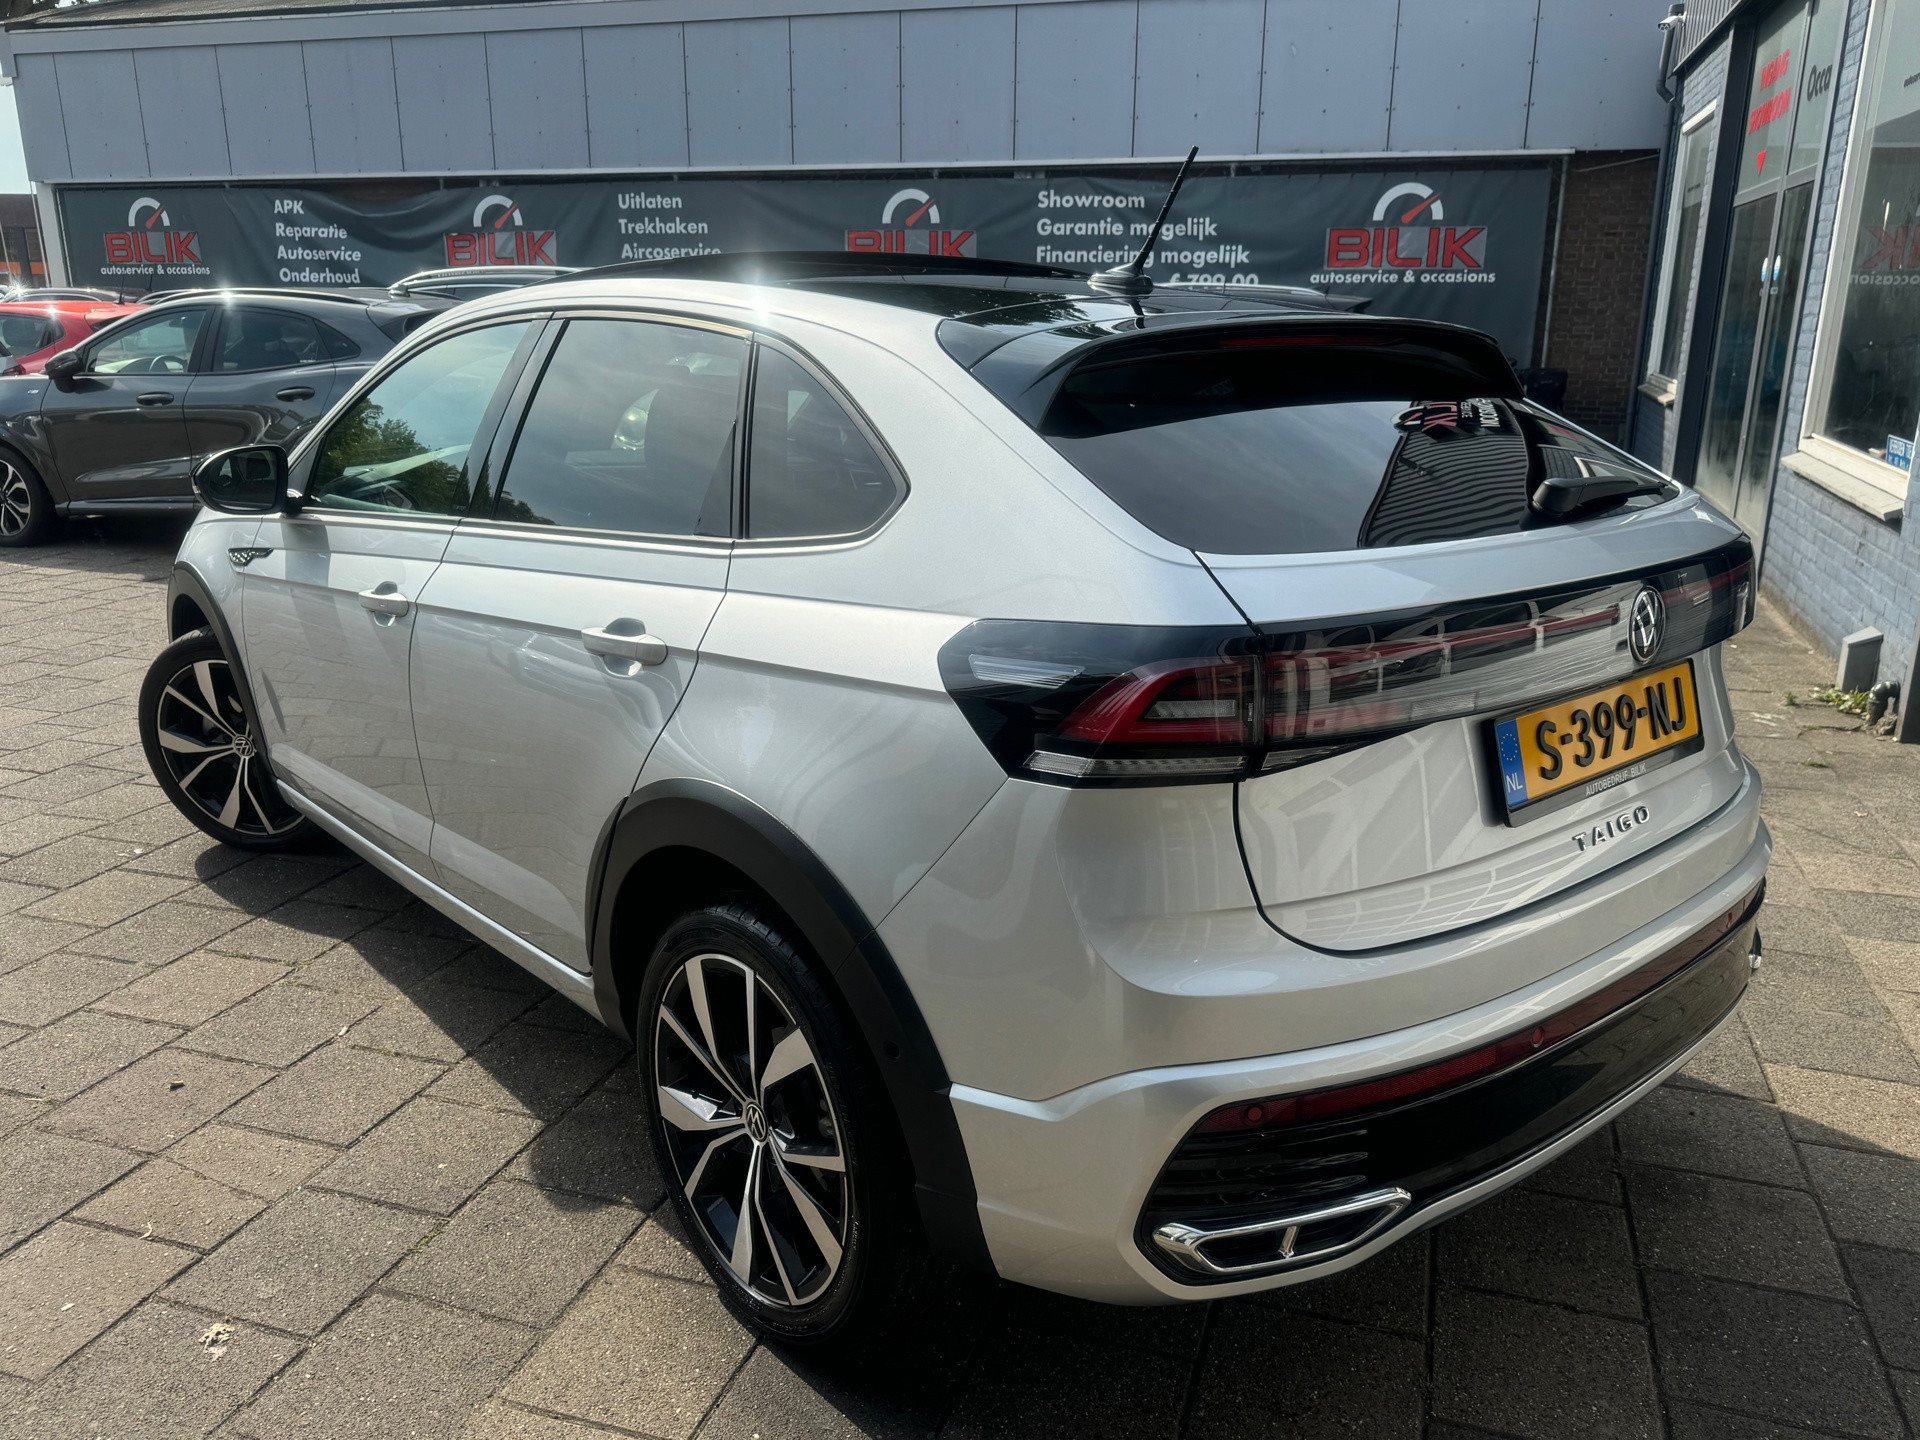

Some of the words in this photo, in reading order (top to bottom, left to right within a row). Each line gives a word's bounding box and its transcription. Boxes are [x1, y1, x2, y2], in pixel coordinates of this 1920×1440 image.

[274, 199, 305, 215] APK
[618, 191, 683, 210] Uitlaten
[1037, 190, 1146, 208] Showroom
[275, 222, 348, 241] Reparatie
[618, 217, 709, 234] Trekhaken
[1036, 217, 1124, 236] Garantie
[104, 231, 202, 263] BILIK
[277, 245, 362, 261] Autoservice
[445, 231, 556, 266] BILIK
[1036, 245, 1155, 268] Financiering
[1160, 245, 1250, 268] mogelijk
[1327, 228, 1486, 268] BILIK
[100, 265, 155, 275] autoservice
[157, 264, 165, 275] &
[166, 264, 211, 275] occasions
[279, 267, 361, 284] Onderhoud
[1310, 270, 1399, 283] autoservice
[1403, 269, 1415, 283] &
[1420, 269, 1496, 283] occasions
[1536, 677, 1687, 780] S-399-NJ
[1506, 774, 1523, 793] NL
[1585, 771, 1629, 797] AUTOBEDRIJF
[1630, 763, 1647, 778] BILIK
[1572, 806, 1651, 851] TAIGO
